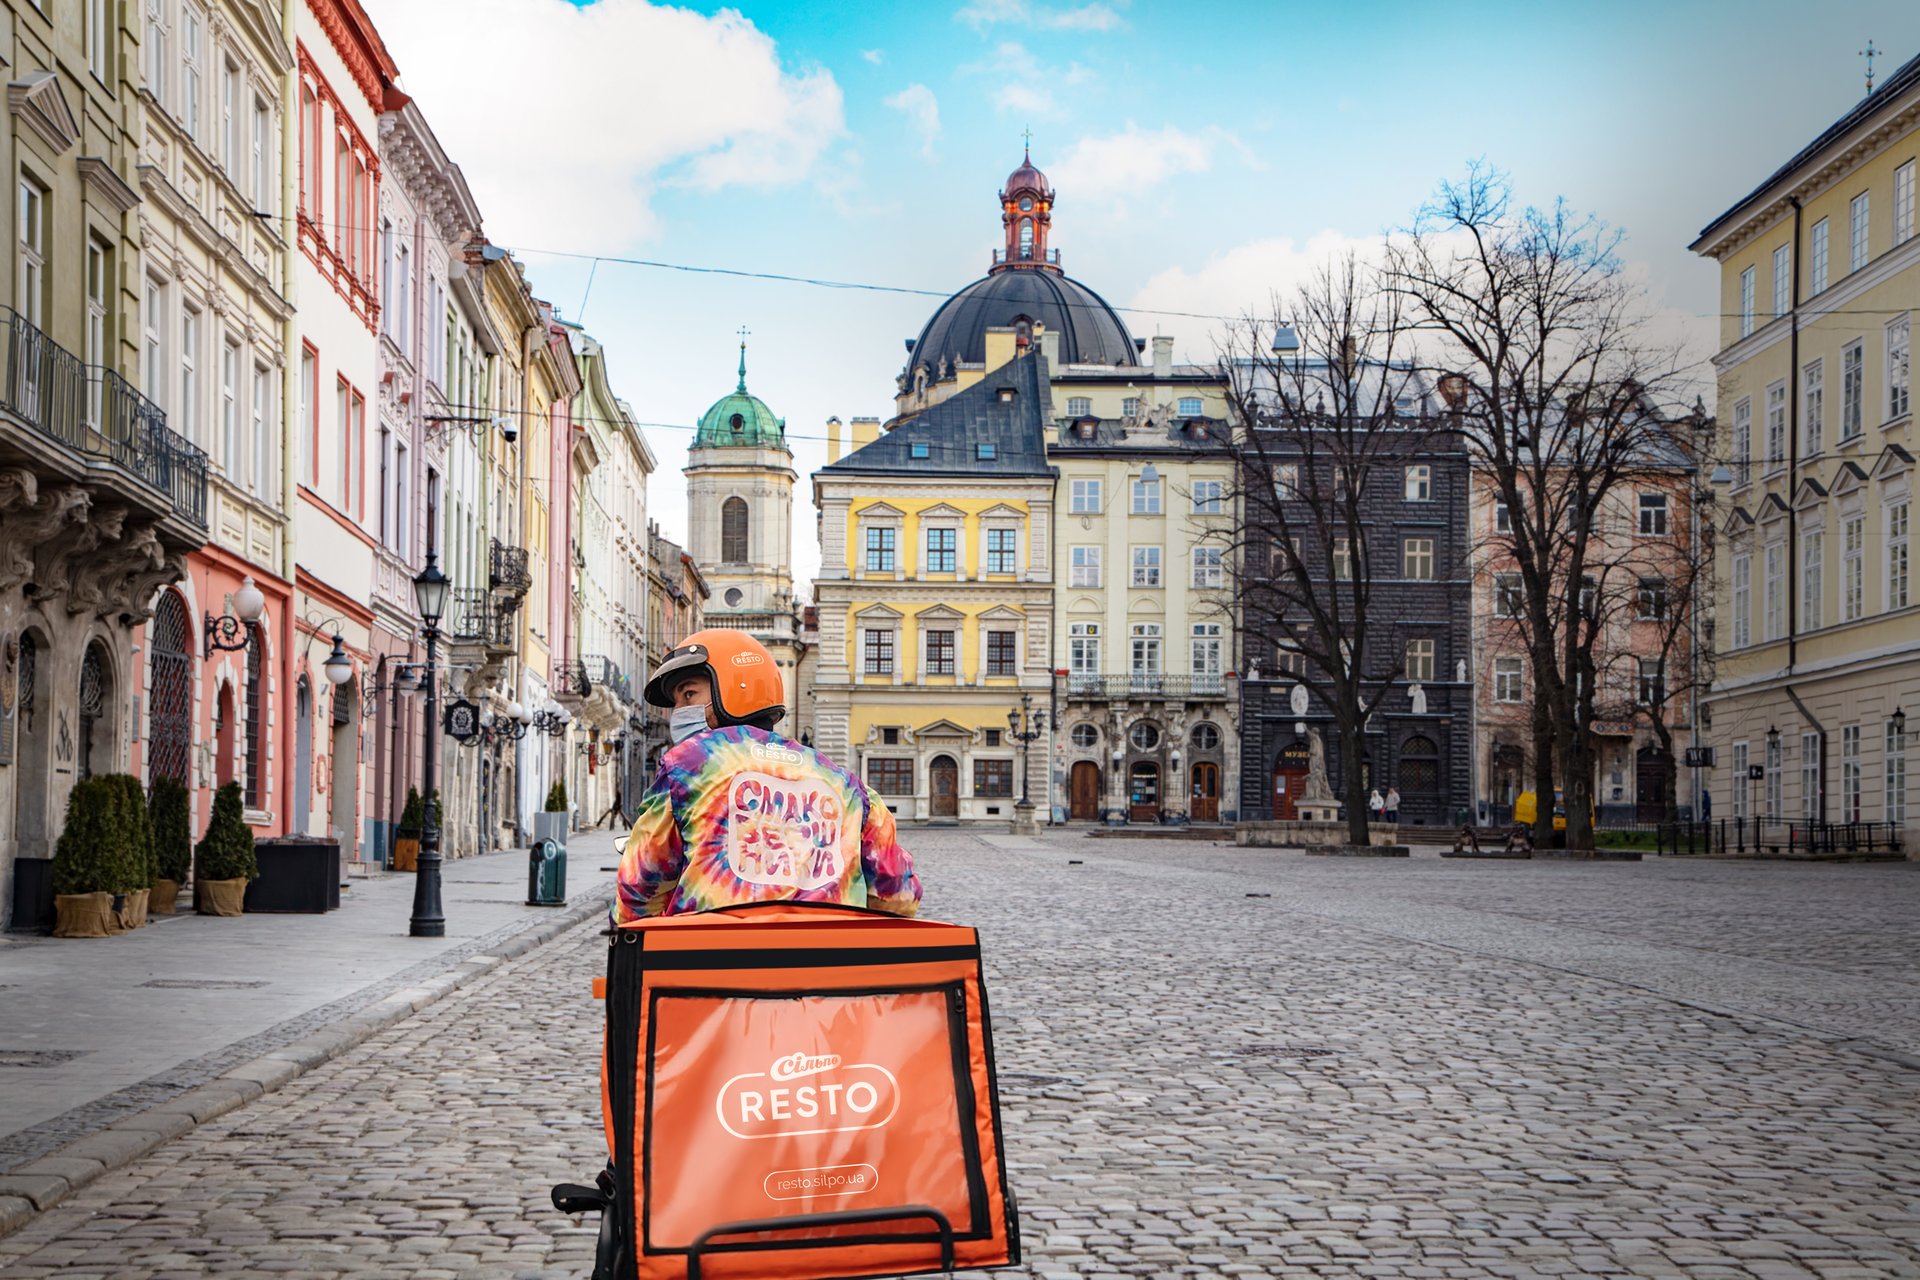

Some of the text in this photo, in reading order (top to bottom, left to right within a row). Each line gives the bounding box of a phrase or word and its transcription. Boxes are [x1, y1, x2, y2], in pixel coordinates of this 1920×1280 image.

[736, 656, 761, 664] RESTO
[757, 748, 797, 761] RESTO
[735, 780, 839, 823] СМАКО
[740, 1081, 878, 1122] RESTO
[777, 1173, 865, 1190] resto.silpo.ua
